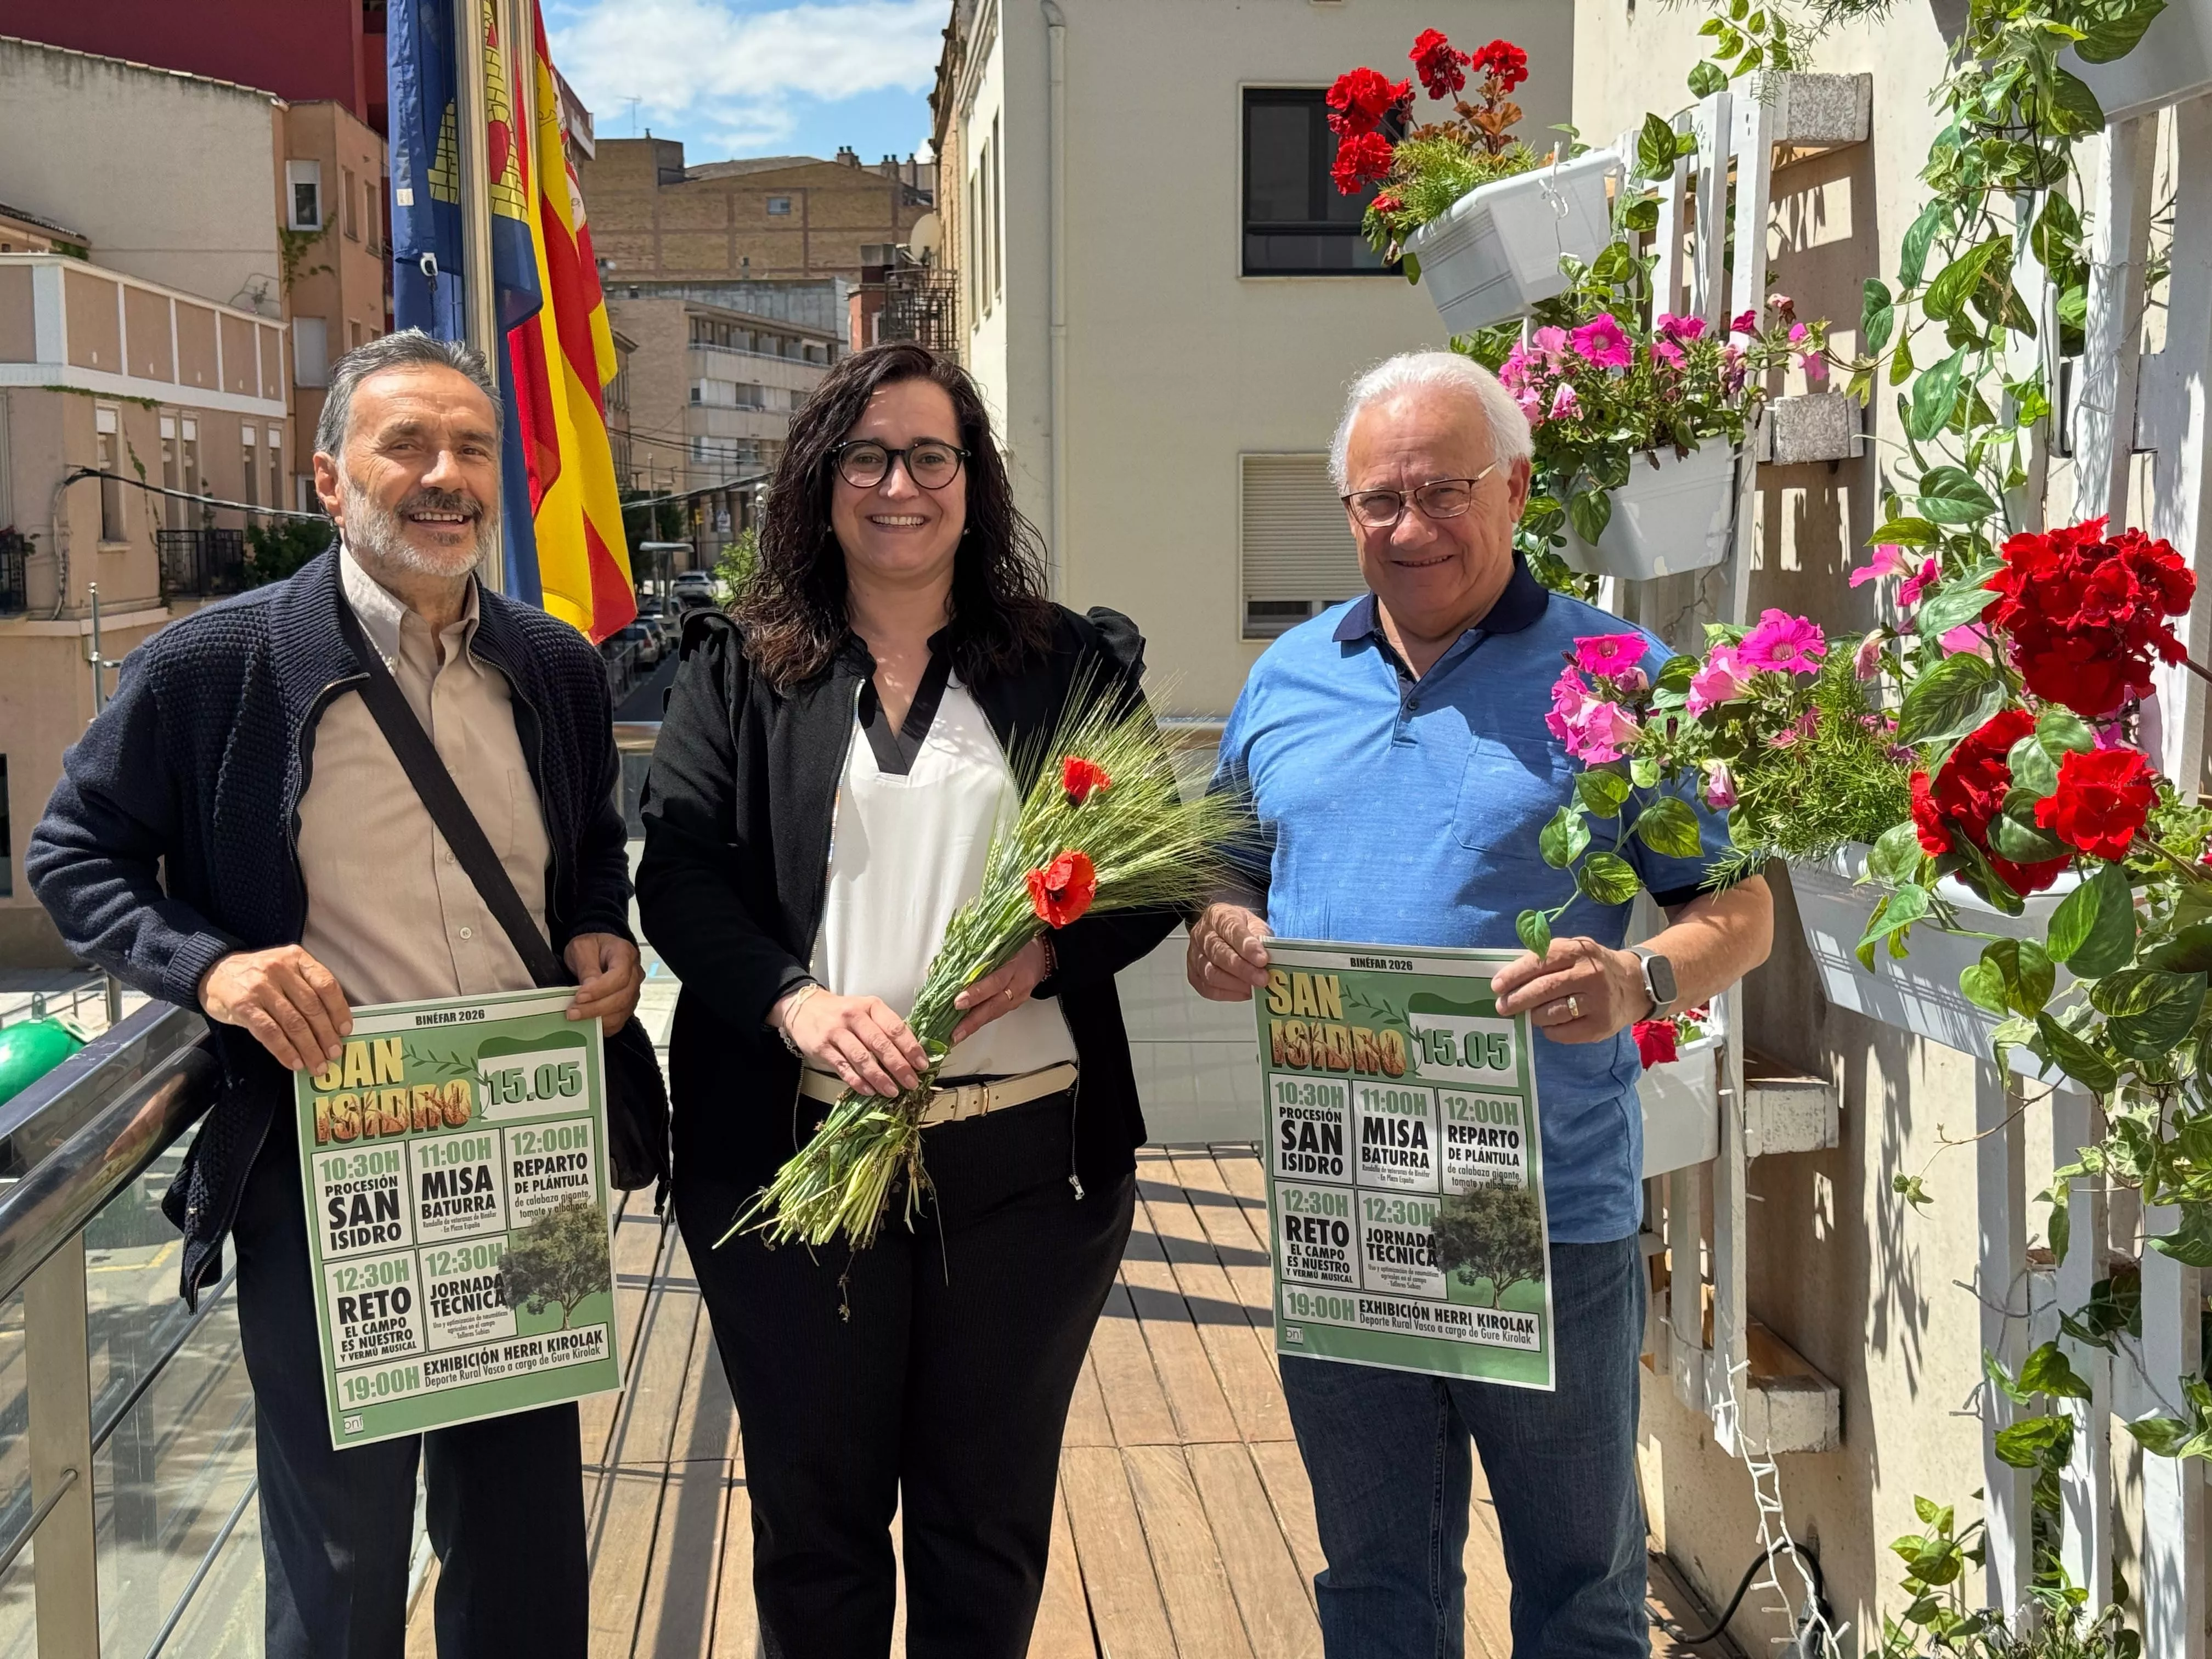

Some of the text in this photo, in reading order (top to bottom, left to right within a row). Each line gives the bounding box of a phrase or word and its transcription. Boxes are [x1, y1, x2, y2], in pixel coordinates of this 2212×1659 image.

[1350, 956, 1413, 970] BINÉFAR 2026
[1265, 969, 1343, 1020] SAN
[415, 1009, 485, 1025] BINÉFAR 2026
[1269, 1019, 1407, 1079] ISIDRO
[1419, 1028, 1511, 1070] 15.05
[488, 1061, 583, 1105] 15.05
[1275, 1081, 1344, 1108] 10:30H
[313, 1079, 472, 1146] ISIDRO
[1279, 1107, 1342, 1123] PROCESIÓN
[1360, 1088, 1427, 1116] 11:00H
[1444, 1097, 1519, 1126] 12:00H
[511, 1125, 588, 1155] 12:00H
[1281, 1119, 1343, 1156] SAN
[1362, 1116, 1429, 1150] MISA
[1448, 1125, 1519, 1149] REPARTO
[320, 1149, 400, 1182] 10:30H
[417, 1137, 492, 1168] 11:00H
[513, 1153, 588, 1178] REPARTO
[1282, 1152, 1344, 1176] ISIDRO
[1362, 1146, 1430, 1169] BATURRA
[1448, 1147, 1520, 1166] DE PLÁNTULA
[325, 1174, 398, 1197] PROCESIÓN
[422, 1165, 494, 1201] MISA
[515, 1173, 589, 1194] DE PLÁNTULA
[1447, 1163, 1521, 1182] de calabaza gigante,
[1452, 1177, 1477, 1188] tomate
[1479, 1181, 1483, 1190] y
[328, 1188, 400, 1230] SAN
[421, 1194, 496, 1220] BATURRA
[515, 1190, 591, 1207] de calabaza gigante,
[520, 1201, 588, 1218] tomate y albahaca
[1282, 1189, 1348, 1217] 12:30H
[1363, 1197, 1435, 1227] 12:30H
[330, 1222, 402, 1251] ISIDRO
[464, 1222, 480, 1231] España
[1285, 1215, 1350, 1248] RETO
[1366, 1228, 1436, 1249] JORNADA
[425, 1243, 503, 1277] 12:30H
[1287, 1256, 1350, 1274] ES NUESTRO
[1290, 1243, 1345, 1261] EL CAMPO
[333, 1258, 410, 1293] 12:30H
[430, 1273, 505, 1300] JORNADA
[1285, 1267, 1353, 1283] Y VERMÚ MUSICAL
[337, 1286, 411, 1325] RETO
[1287, 1293, 1356, 1322] 19:00H
[1359, 1299, 1534, 1334] EXHIBICIÓN HERRI KIROLAK
[341, 1329, 413, 1352] ES NUESTRO
[345, 1317, 407, 1339] EL CAMPO
[1360, 1314, 1390, 1327] Deporte
[1392, 1317, 1412, 1330] Rural
[1414, 1320, 1435, 1333] Vasco
[1445, 1326, 1466, 1338] cargo
[1469, 1325, 1479, 1338] de
[1481, 1328, 1500, 1340] Gure
[1503, 1330, 1531, 1345] Kirolak
[340, 1341, 417, 1362] Y VERMÚ MUSICAL
[424, 1330, 603, 1376] EXHIBICIÓN HERRI KIROLAK
[425, 1373, 457, 1387] Deporte
[460, 1365, 481, 1381] Rural
[483, 1364, 505, 1375] Vasco
[515, 1358, 537, 1369] cargo
[539, 1354, 549, 1365] de
[551, 1352, 570, 1363] Gure
[573, 1344, 601, 1359] Kirolak
[343, 1365, 420, 1402] 19:00H
